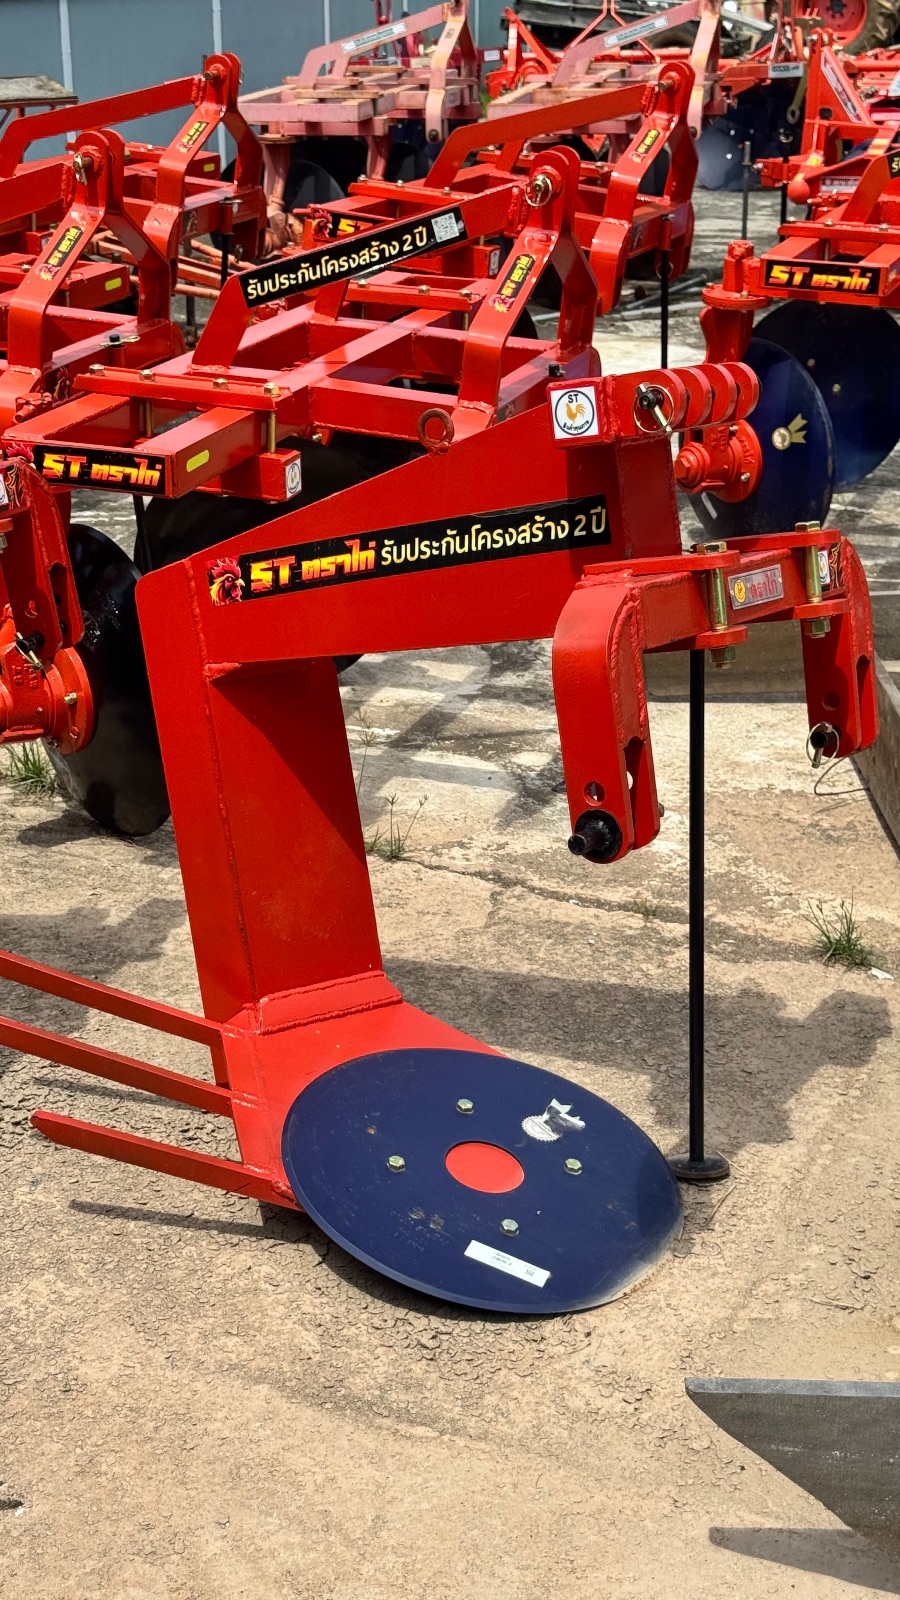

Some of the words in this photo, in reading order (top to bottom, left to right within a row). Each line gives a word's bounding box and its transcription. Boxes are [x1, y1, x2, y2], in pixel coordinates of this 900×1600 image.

[247, 240, 400, 300] รับประกันโครงสร้าง
[403, 235, 414, 251] 2
[415, 226, 428, 247] ปี
[768, 265, 810, 286] ST
[811, 268, 873, 291] ตราไก่
[567, 393, 579, 404] ST
[42, 453, 87, 479] ST
[90, 457, 163, 487] ตราไก่
[250, 555, 296, 593] ST
[301, 538, 377, 582] ตราไก่
[381, 514, 570, 566] รับประกันโครงสร้าง
[573, 514, 587, 537] 2
[590, 506, 606, 534] ปี
